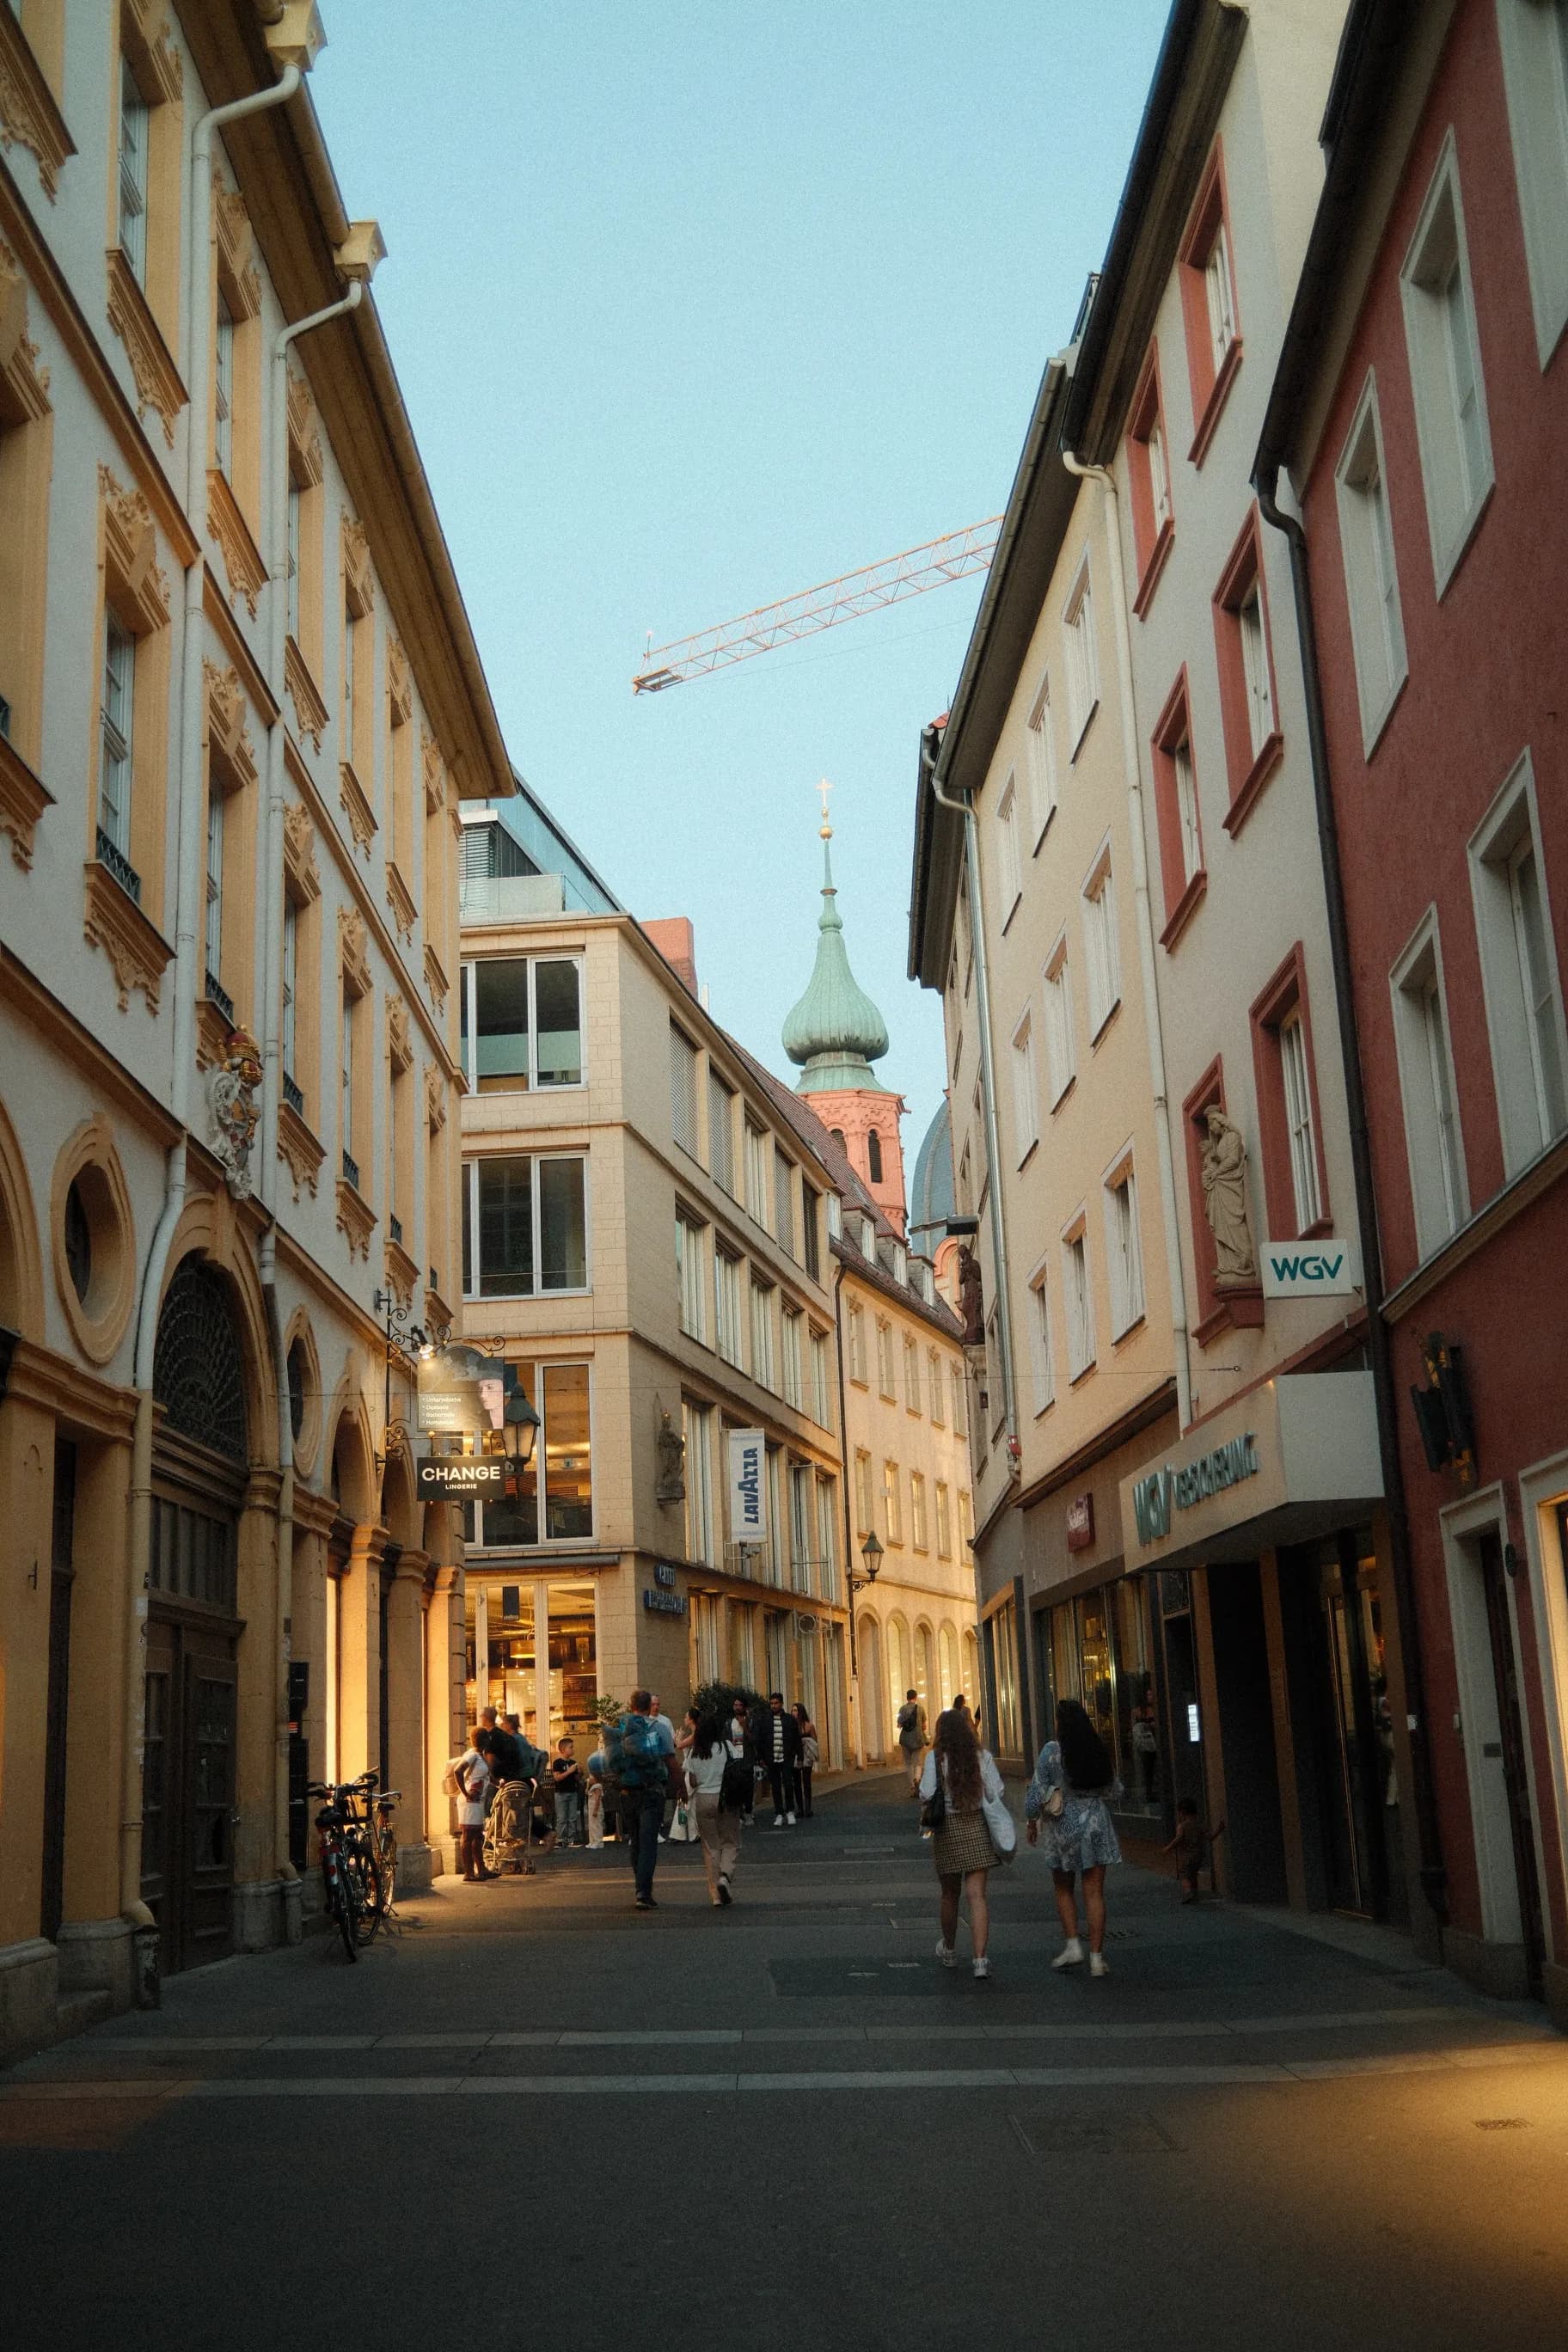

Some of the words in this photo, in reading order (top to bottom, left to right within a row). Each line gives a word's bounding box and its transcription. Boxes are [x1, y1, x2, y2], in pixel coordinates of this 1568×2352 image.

[1271, 1254, 1343, 1281] WGV
[422, 1467, 500, 1481] CHANGE
[738, 1448, 758, 1524] LAVAZZA
[1134, 1463, 1172, 1546] WGV
